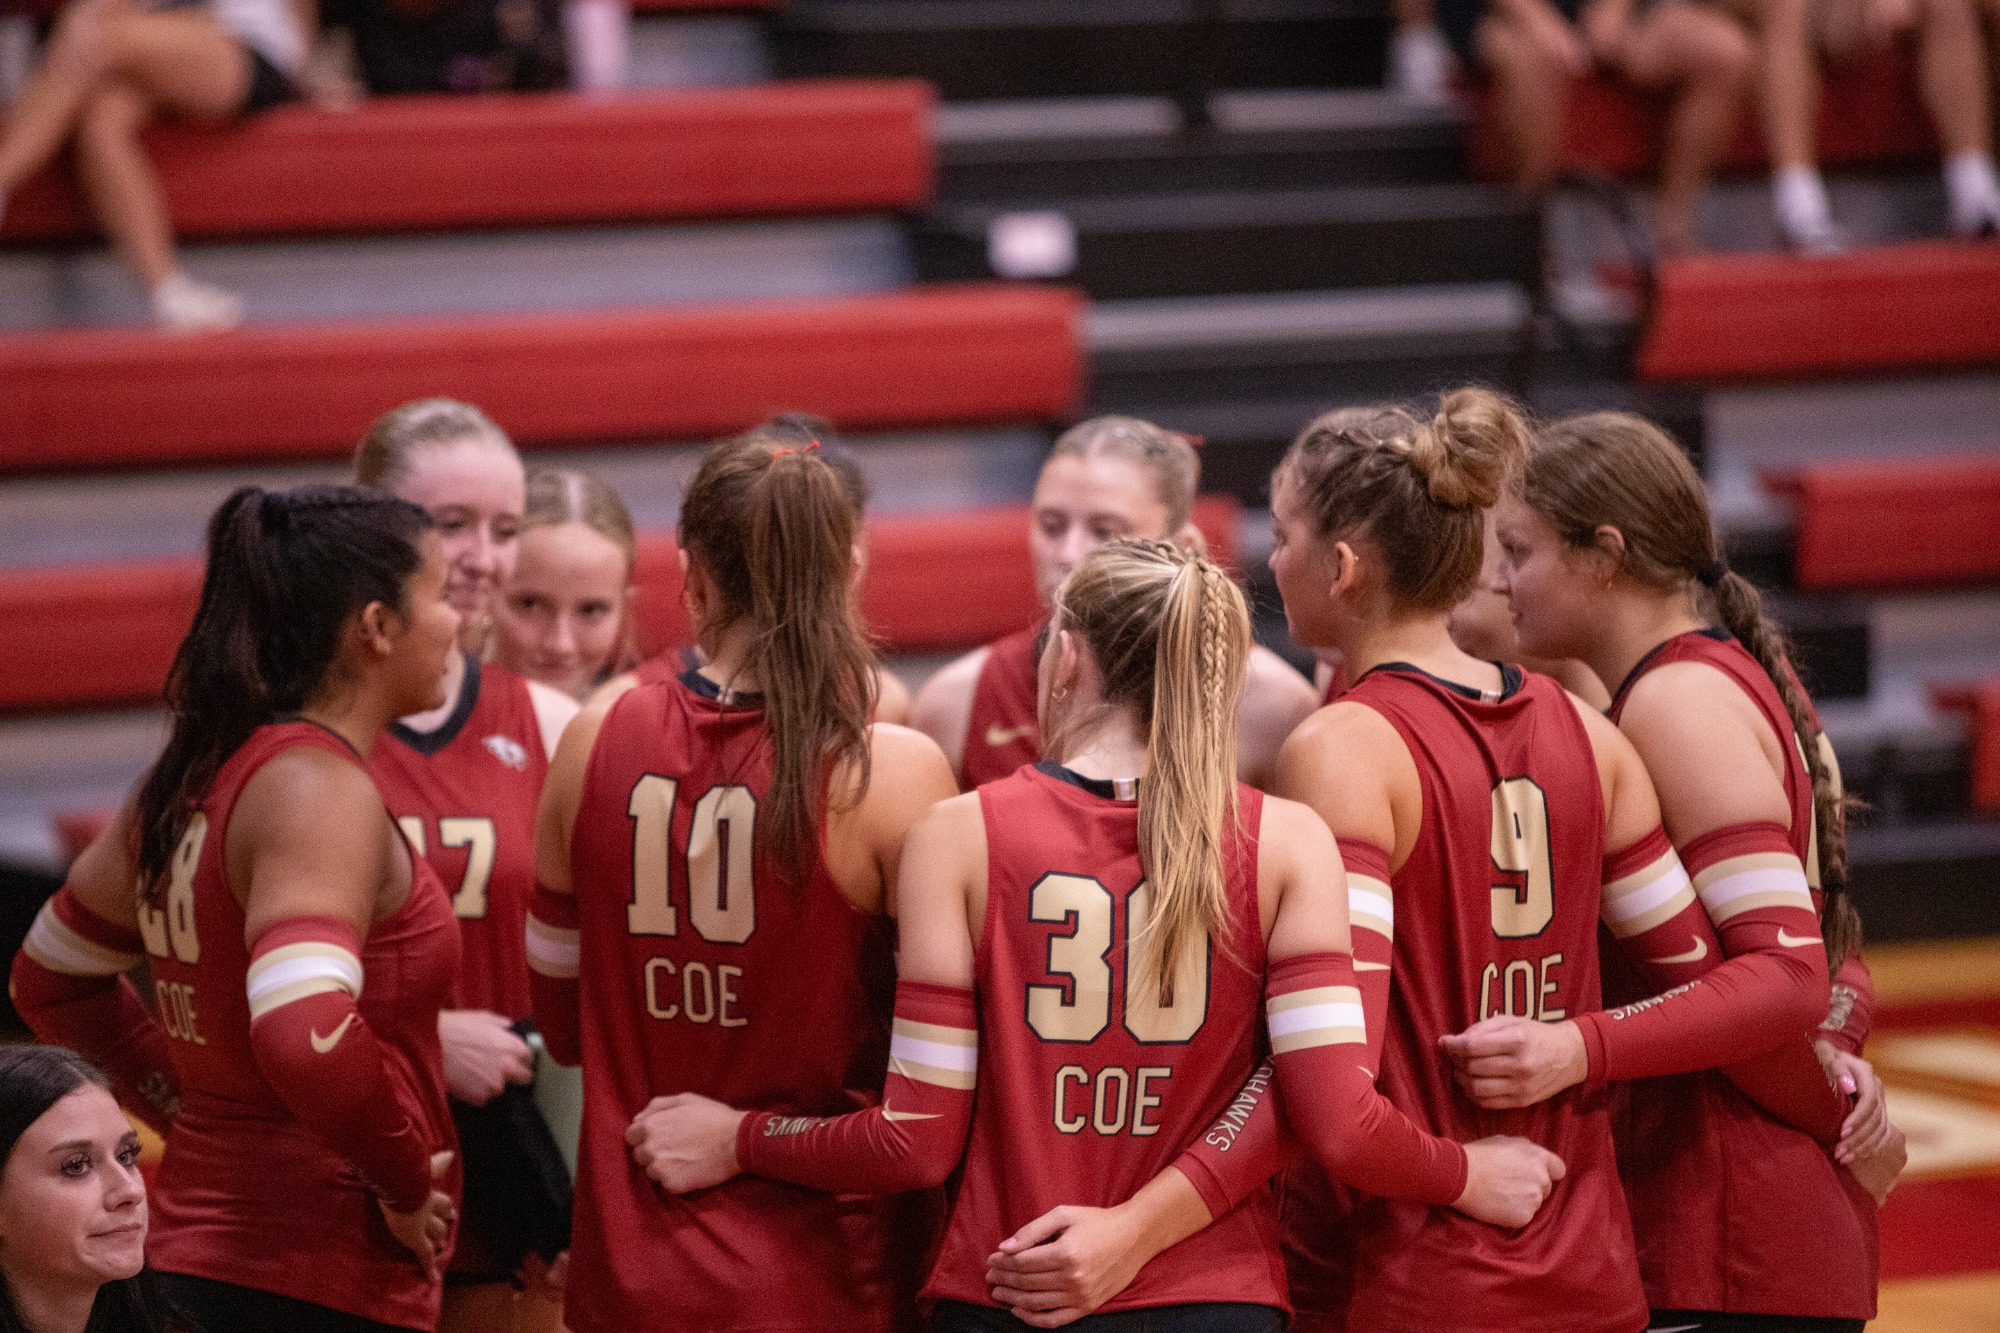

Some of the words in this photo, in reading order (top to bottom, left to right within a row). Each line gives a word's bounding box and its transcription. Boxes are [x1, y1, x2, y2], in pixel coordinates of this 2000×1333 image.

[398, 814, 497, 919] 7
[627, 772, 756, 944] 10
[1490, 775, 1554, 940] 9
[644, 957, 748, 1027] COE
[1024, 871, 1213, 1045] 30
[1478, 952, 1566, 1023] COE
[156, 979, 207, 1045] COE
[1053, 1063, 1173, 1136] COE
